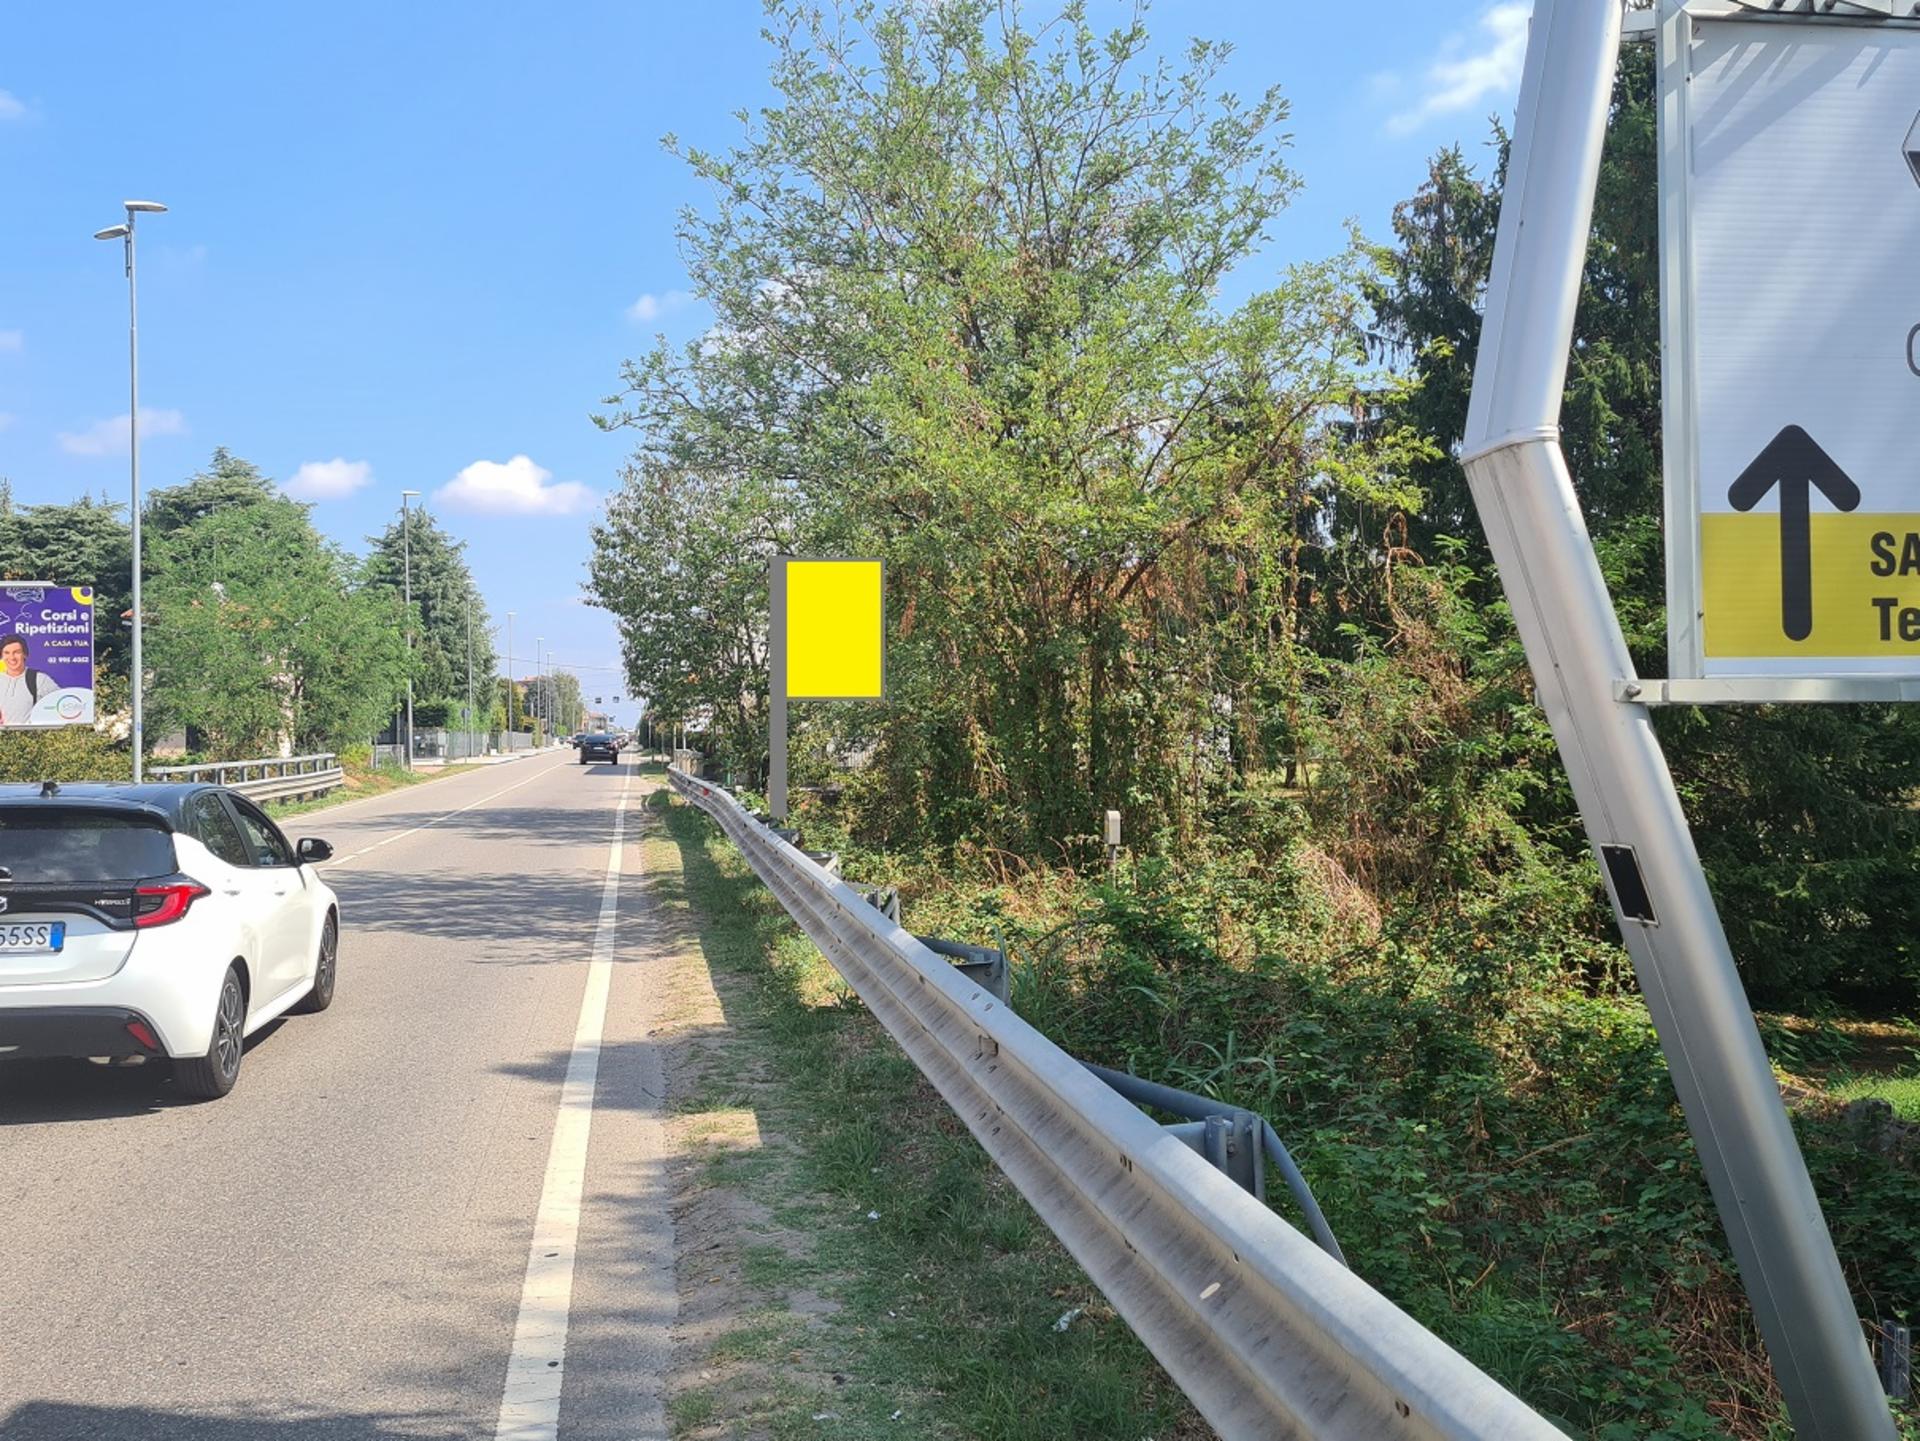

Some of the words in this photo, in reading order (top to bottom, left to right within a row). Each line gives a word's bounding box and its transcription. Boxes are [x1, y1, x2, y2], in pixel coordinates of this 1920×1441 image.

[41, 609, 77, 621] Corsi
[80, 612, 89, 621] e
[15, 622, 89, 636] Ripetizioni
